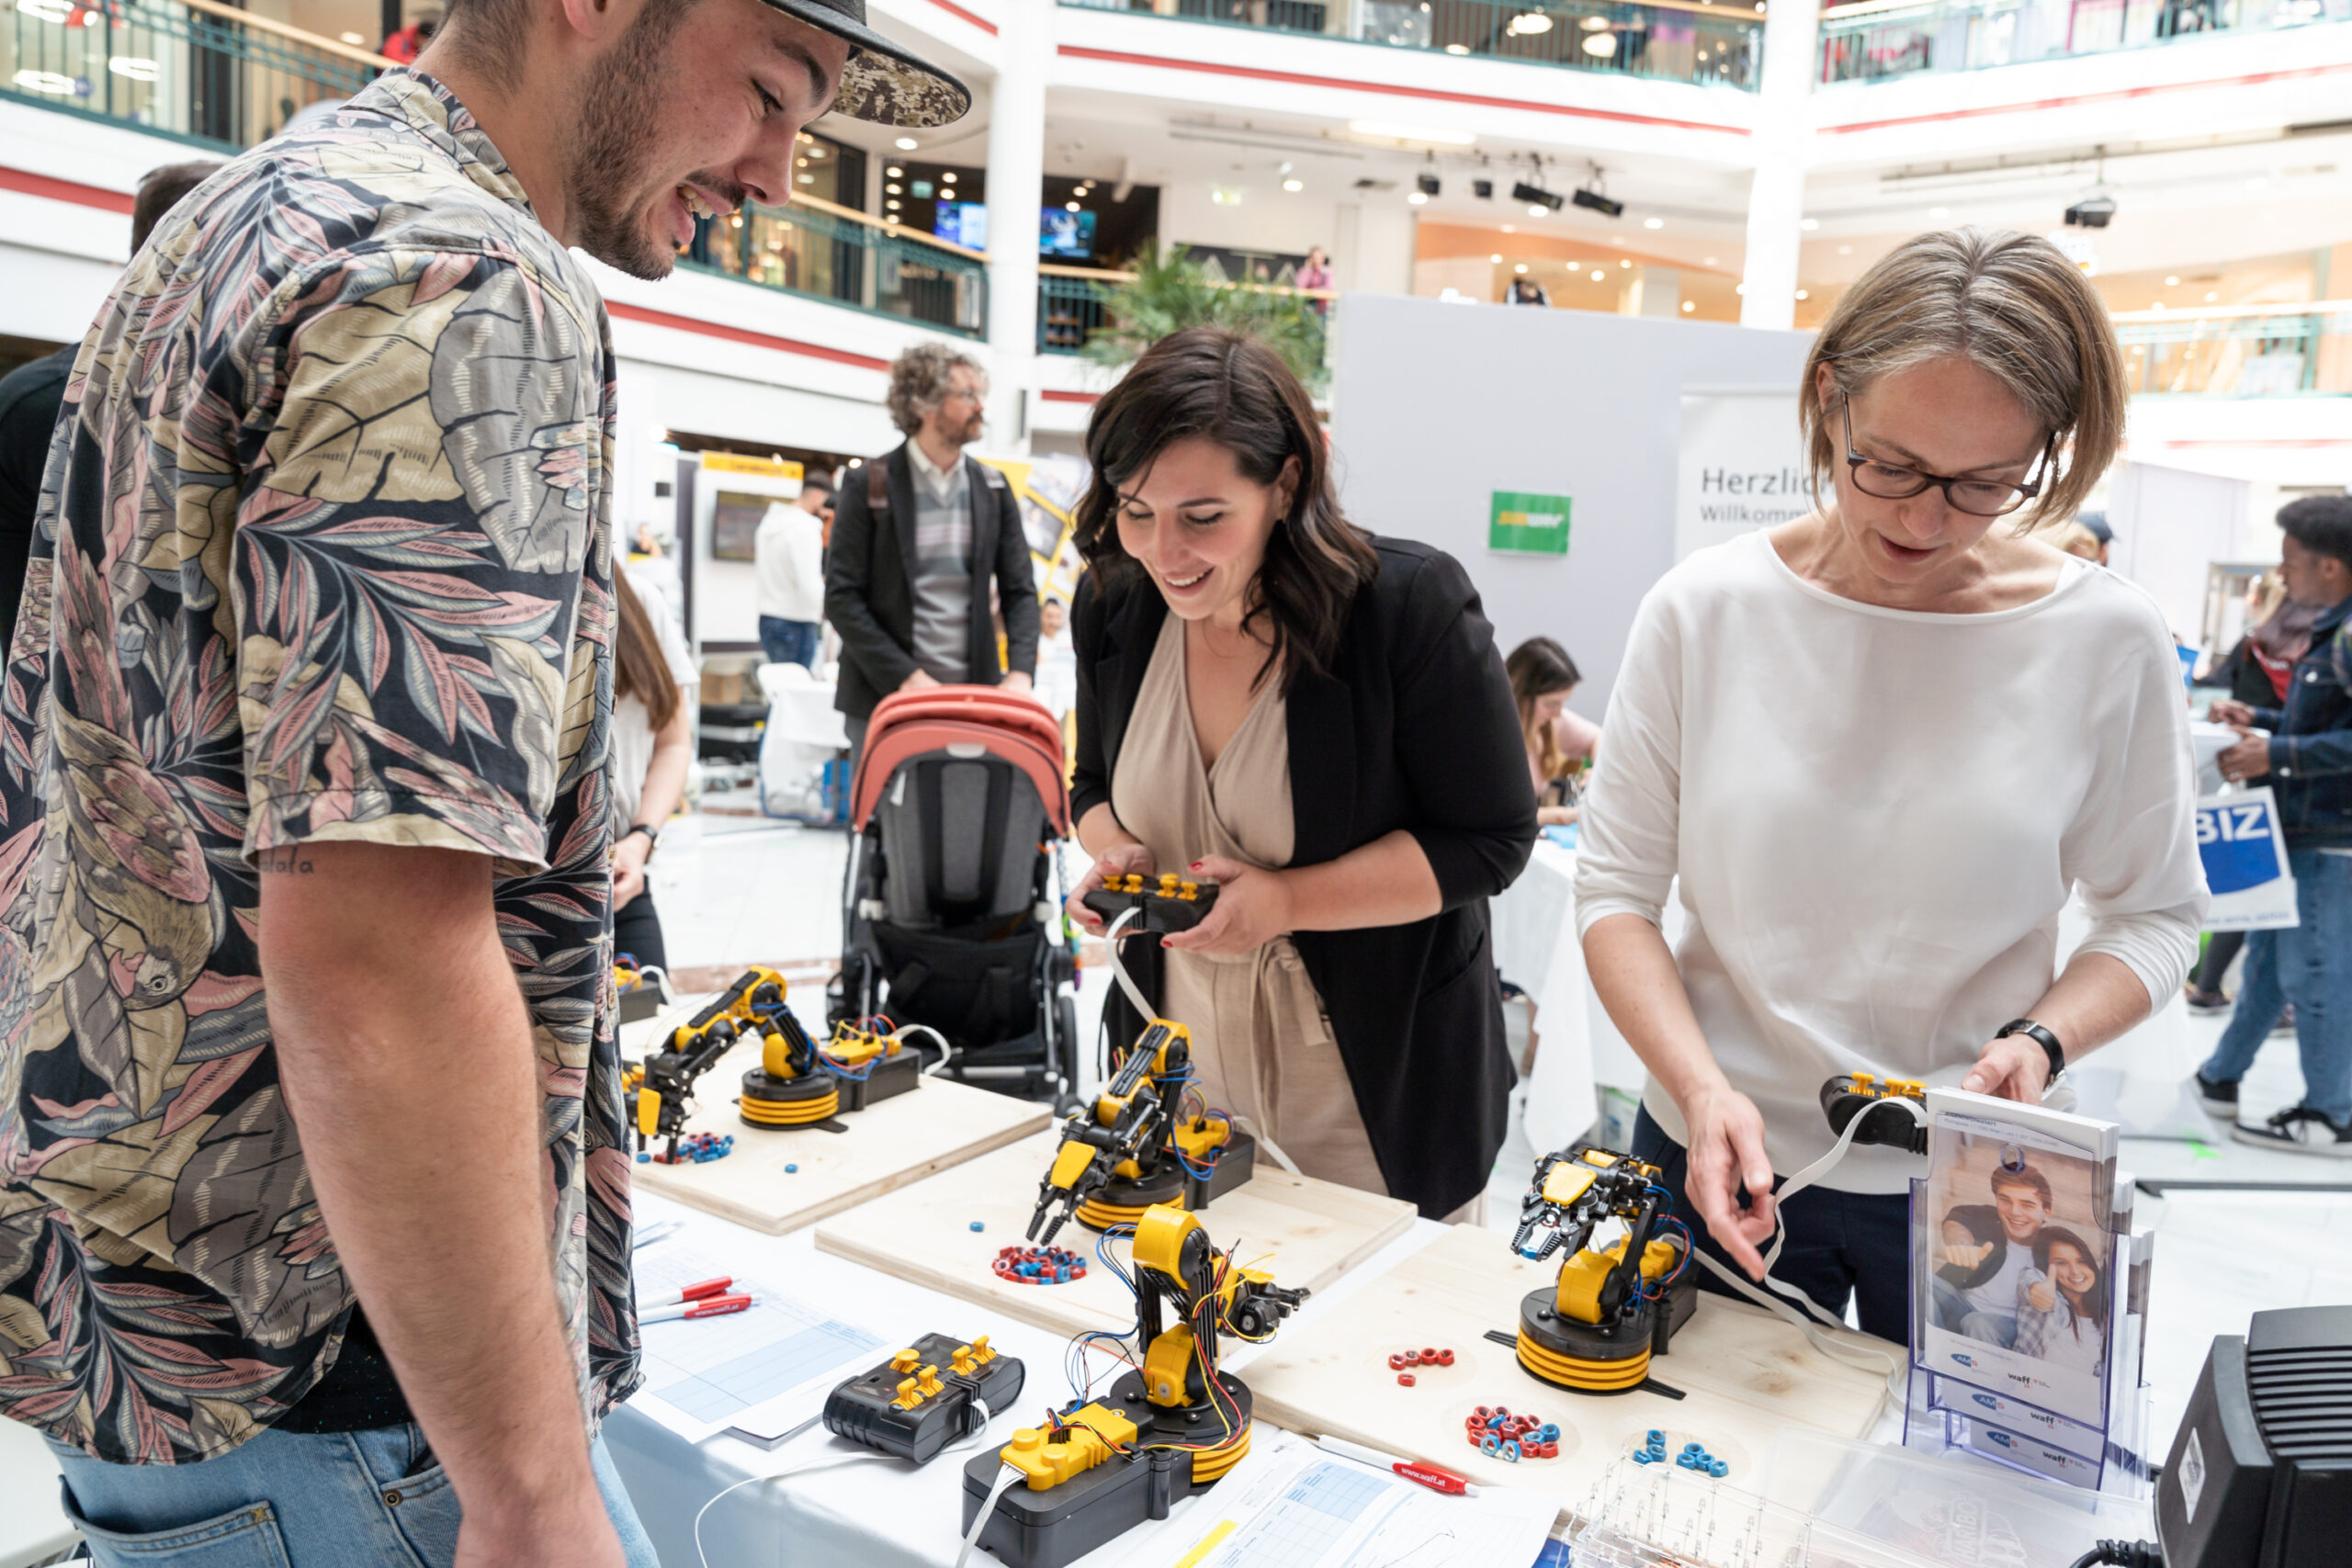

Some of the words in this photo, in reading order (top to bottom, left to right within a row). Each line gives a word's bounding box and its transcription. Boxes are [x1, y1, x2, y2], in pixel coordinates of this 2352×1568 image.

[2197, 805, 2270, 844] BIZ
[2007, 1372, 2031, 1384] waff
[1979, 1395, 2005, 1410] AMS
[2030, 1412, 2054, 1425] waff
[1994, 1433, 2018, 1448] AMS
[2042, 1450, 2066, 1464] waff
[1401, 1467, 1446, 1487] www.waff.at
